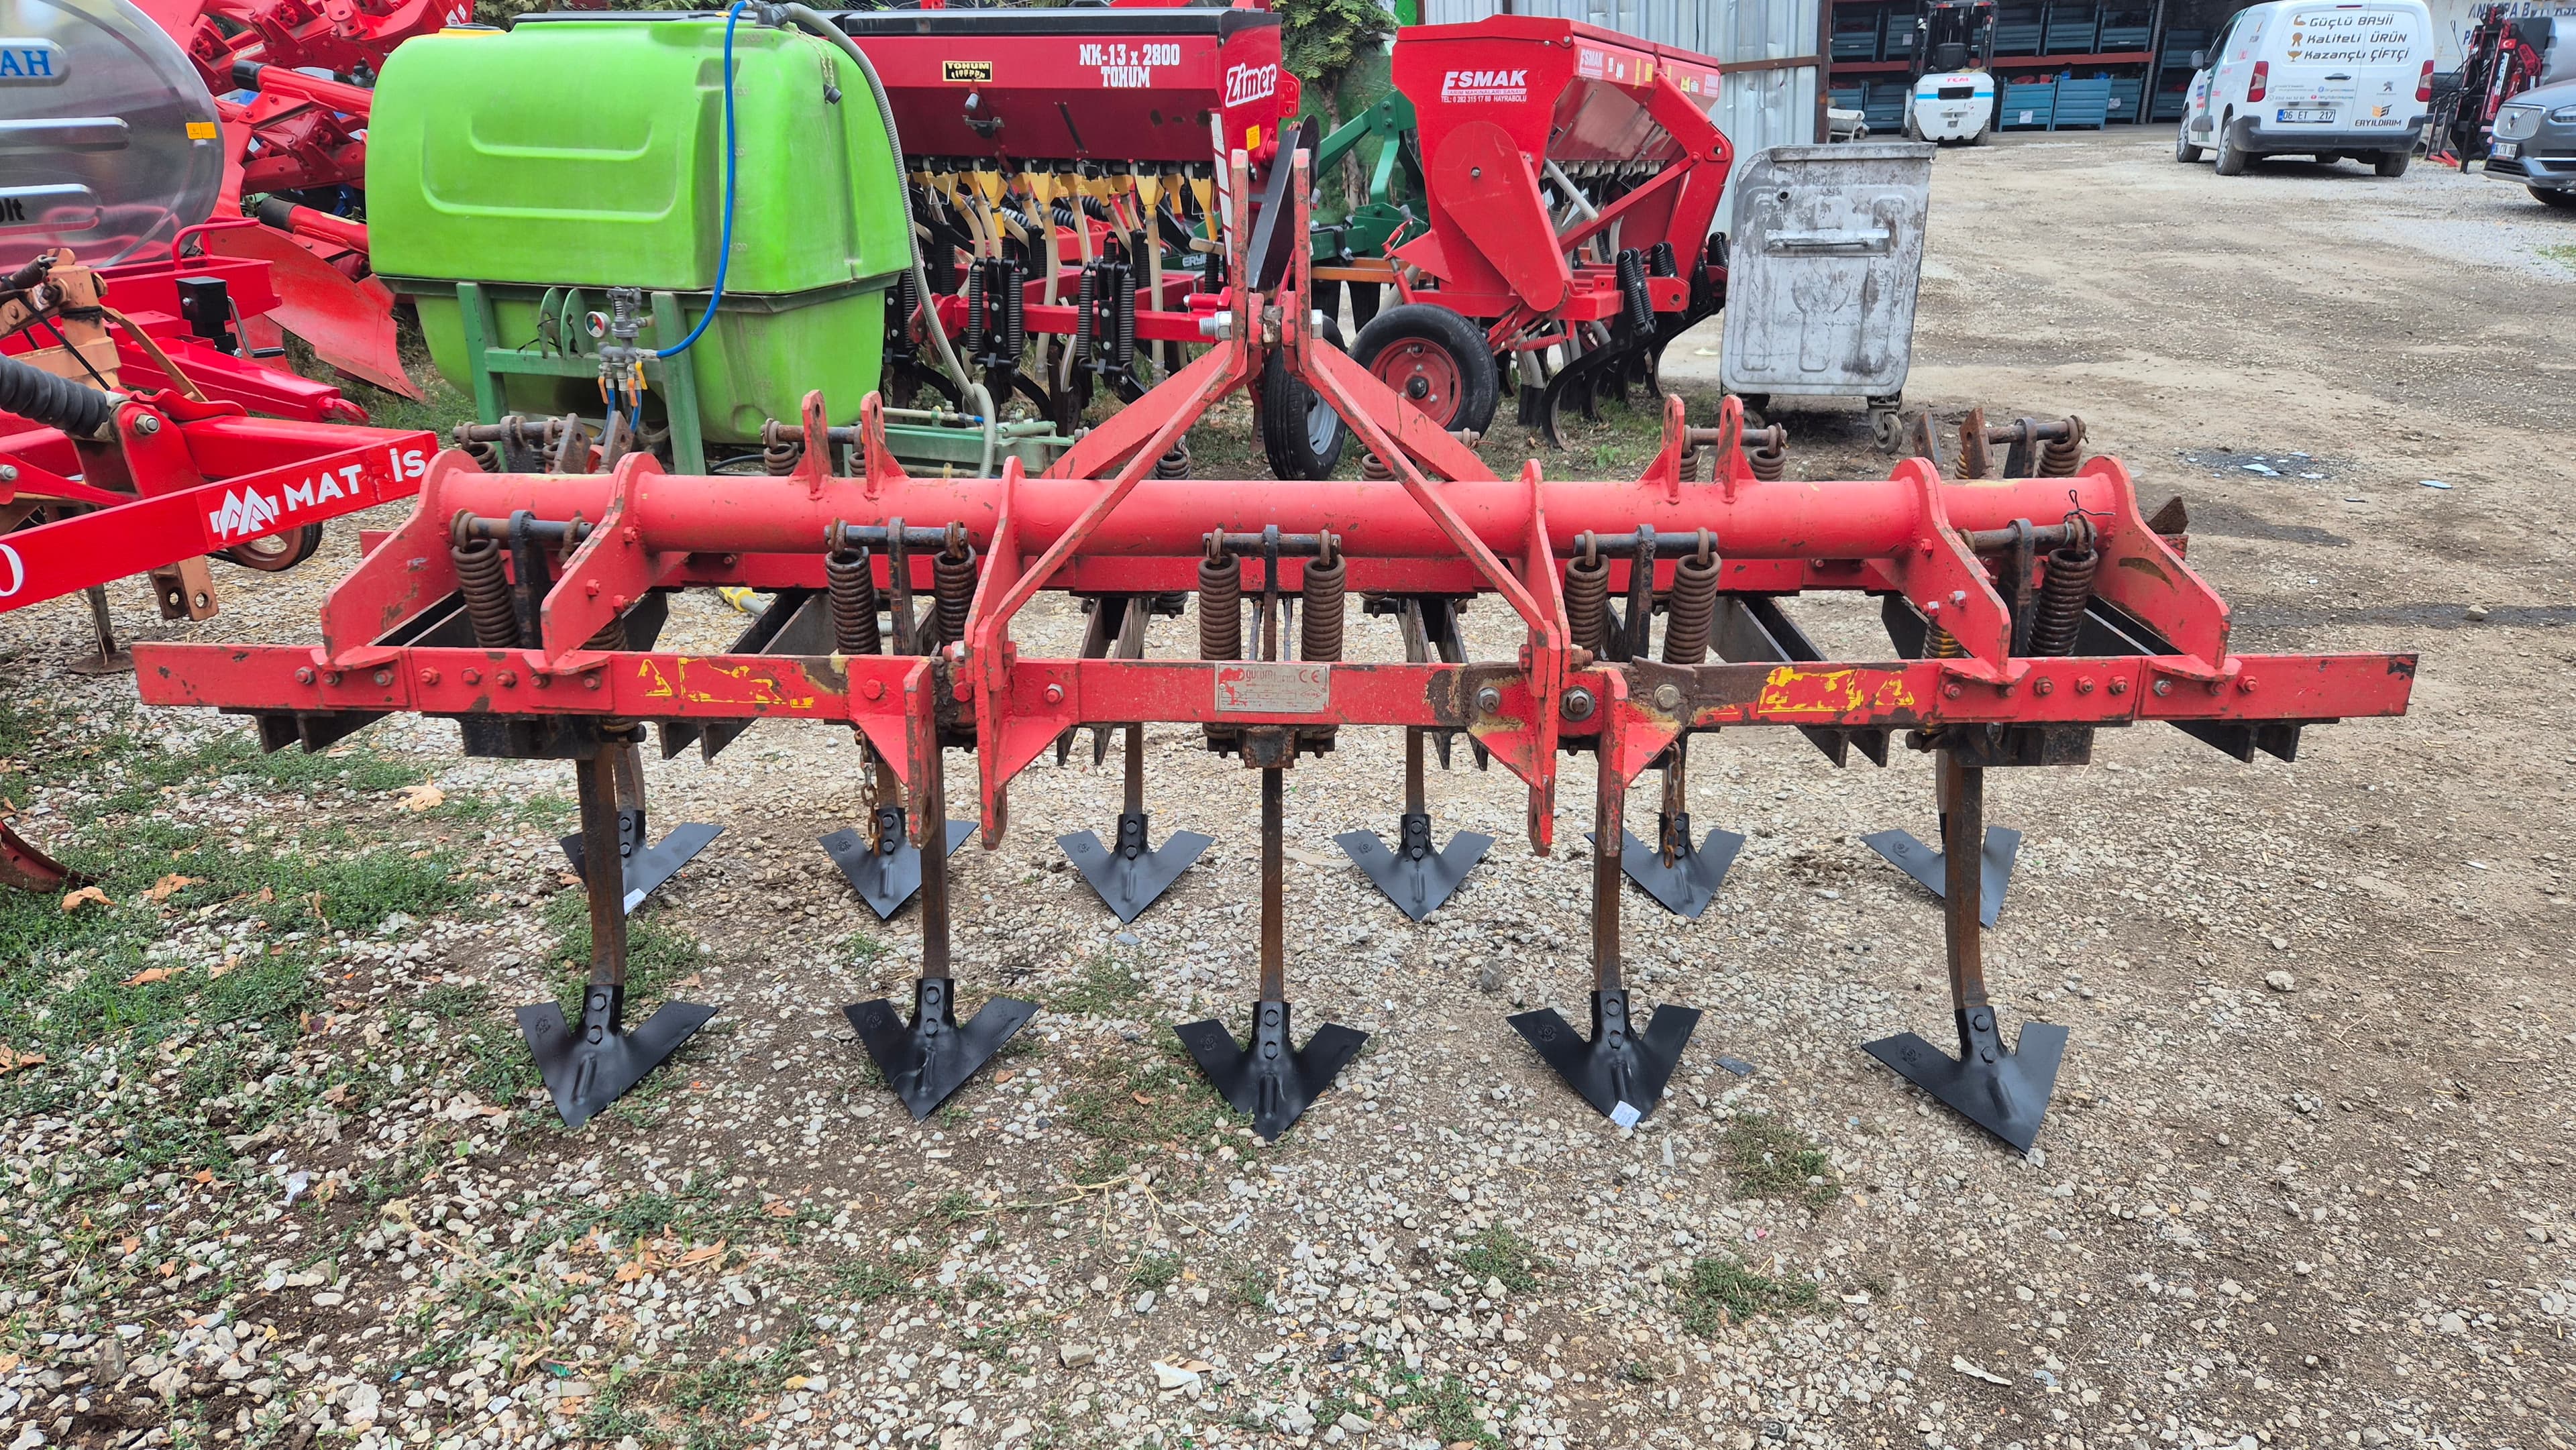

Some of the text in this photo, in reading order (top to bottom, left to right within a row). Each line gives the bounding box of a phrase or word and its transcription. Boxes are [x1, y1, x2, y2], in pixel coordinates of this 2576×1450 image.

[2307, 31, 2407, 44] Kaliteli ÜRÜN
[1079, 44, 1180, 66] NK-13 x 2800
[2371, 48, 2410, 62] ÇİFTÇİ
[1101, 66, 1150, 88] TOHUM
[1226, 63, 1276, 107] Zimer
[1442, 70, 1528, 90] ESMAK
[2284, 111, 2334, 119] 06 ET 217
